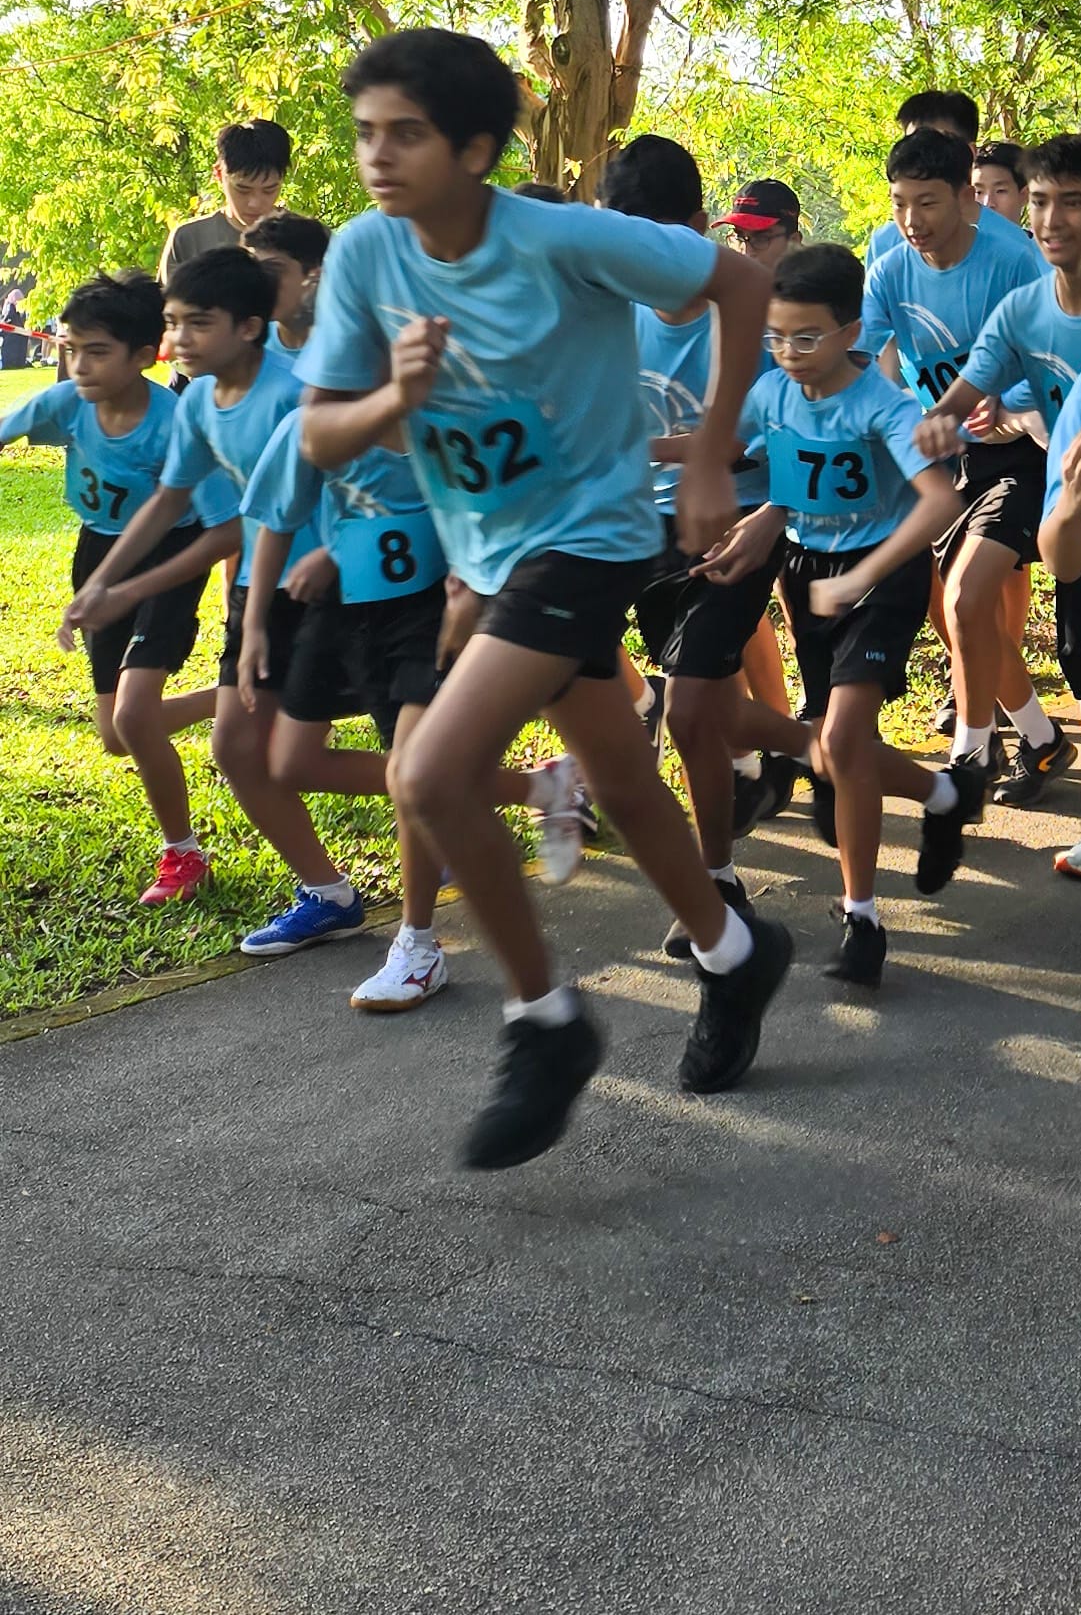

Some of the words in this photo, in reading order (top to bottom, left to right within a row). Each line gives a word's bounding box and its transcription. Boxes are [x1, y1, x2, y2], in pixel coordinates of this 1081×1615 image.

[424, 419, 543, 493] 132
[798, 450, 869, 500] 73
[80, 467, 129, 520] 37
[379, 530, 416, 582] 8
